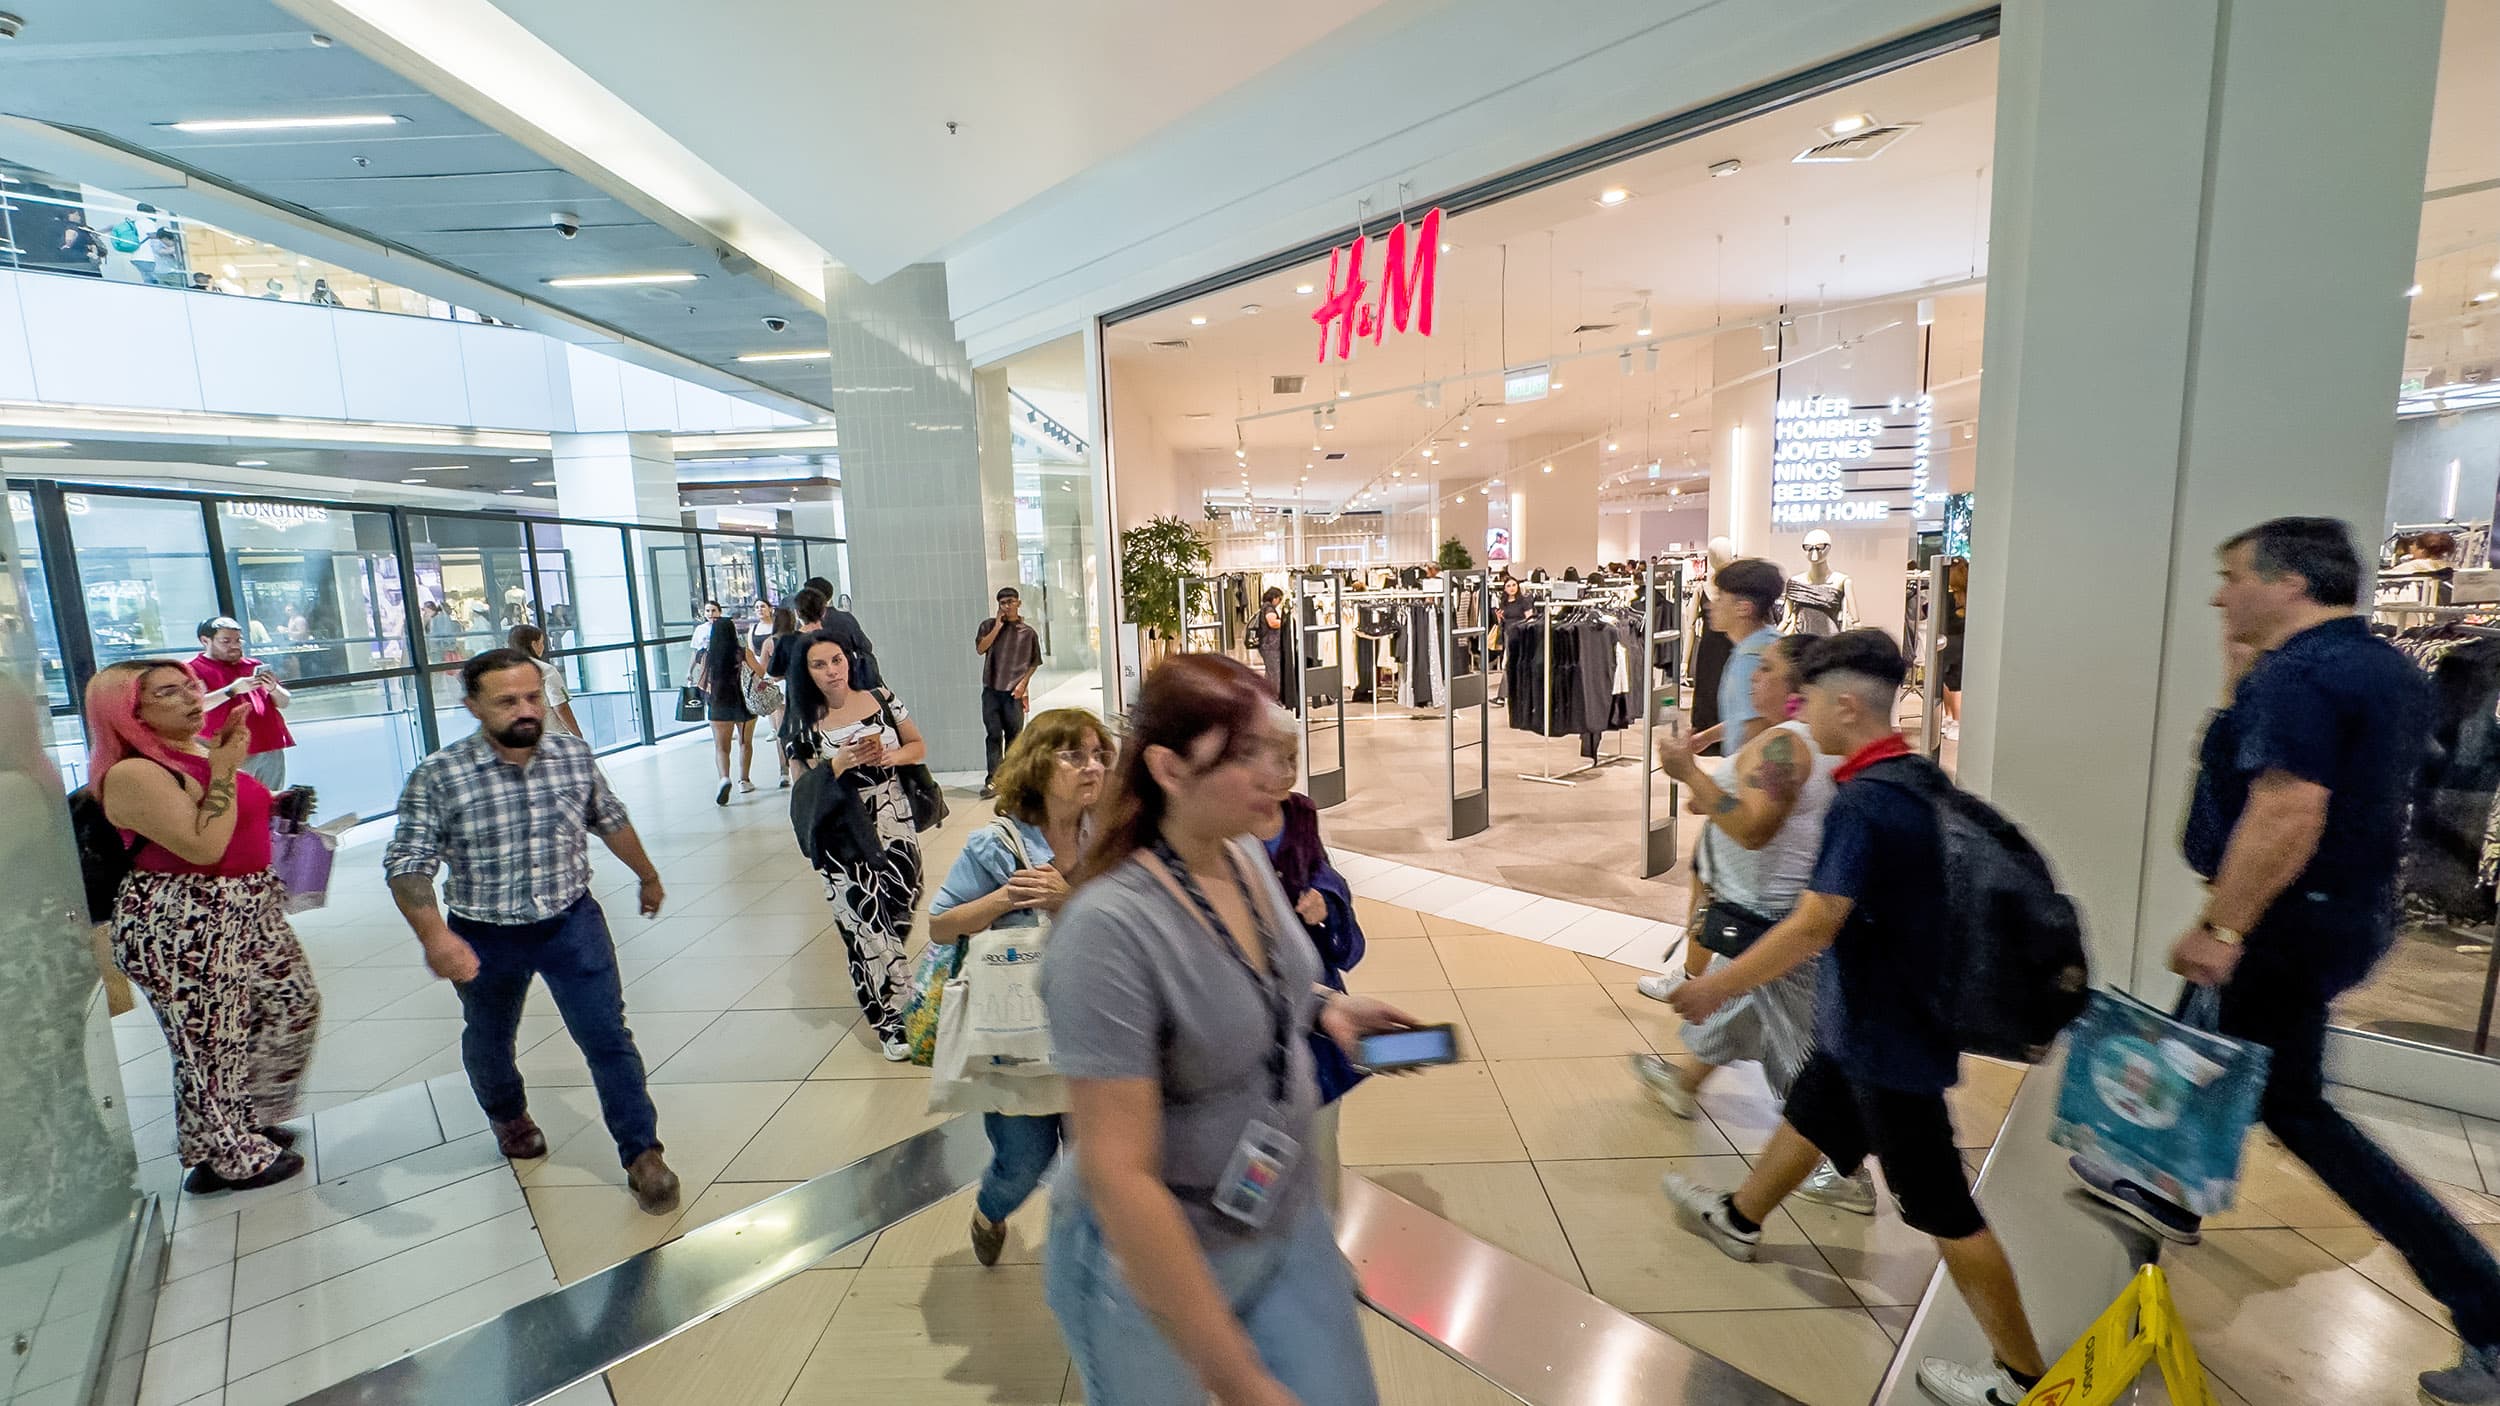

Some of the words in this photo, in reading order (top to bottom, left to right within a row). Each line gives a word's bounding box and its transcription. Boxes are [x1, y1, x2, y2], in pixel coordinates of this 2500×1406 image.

[1312, 207, 1440, 363] H&M
[1776, 398, 1850, 419] MUJER
[1917, 395, 1934, 414] 2
[1775, 418, 1882, 440] HOMBRES
[1916, 416, 1932, 434] 2
[1774, 439, 1873, 461] JOVENES
[1915, 438, 1931, 456] 2
[1914, 459, 1930, 476] 2
[1773, 482, 1844, 503] BEBES
[1912, 478, 1928, 497] 2
[231, 502, 328, 519] LONGINES
[1773, 503, 1821, 522] H&M
[1825, 501, 1889, 521] HOME
[1912, 500, 1926, 517] 3
